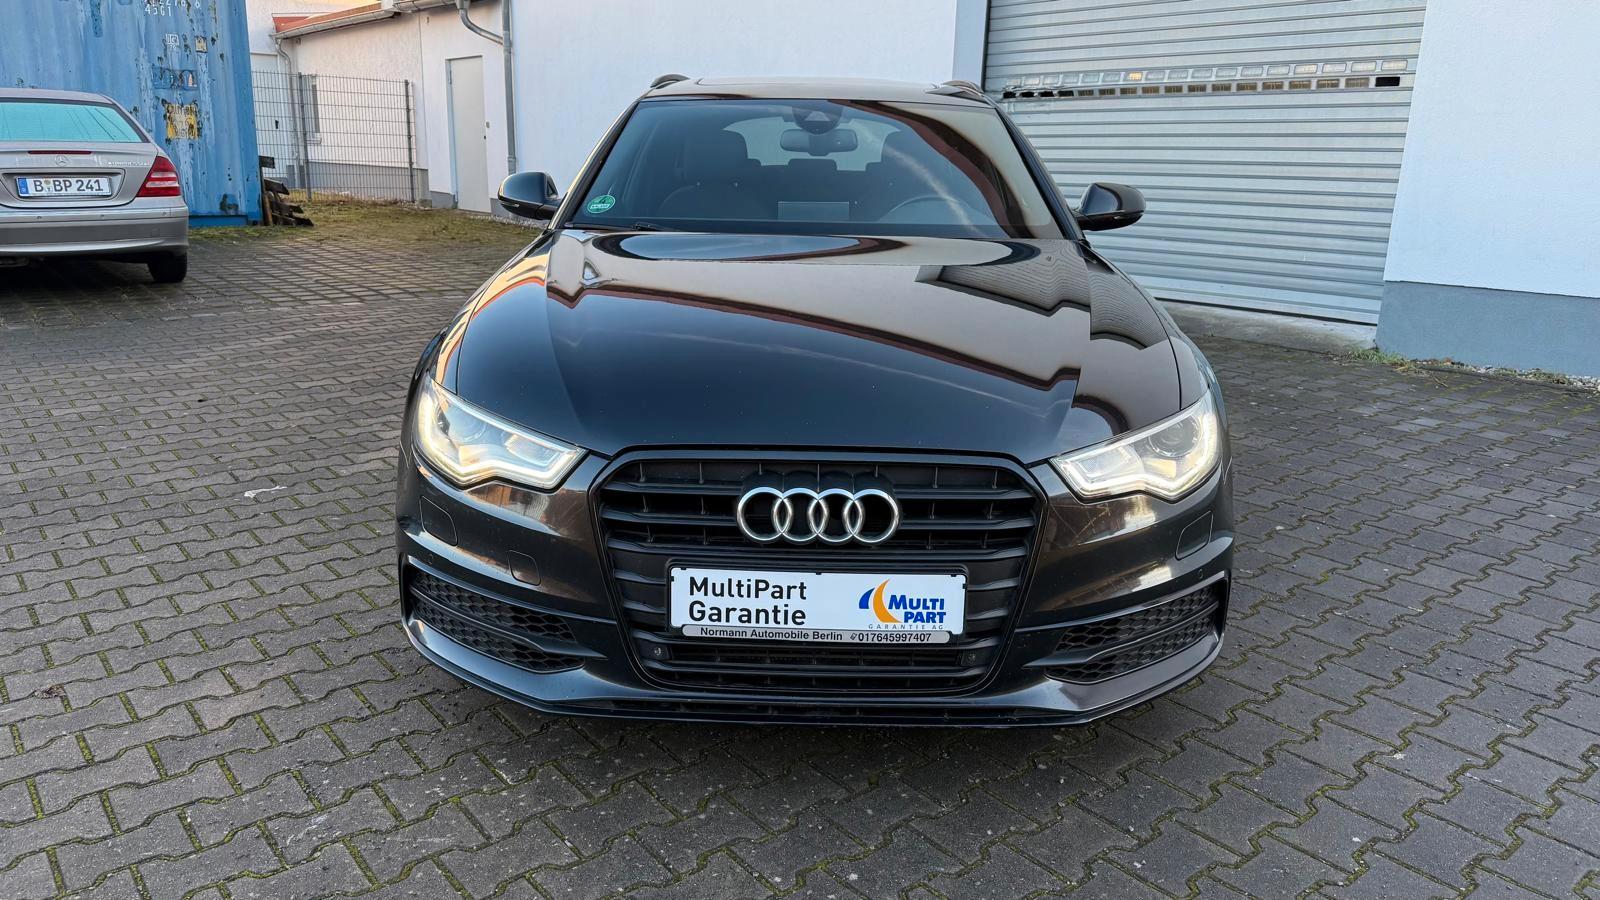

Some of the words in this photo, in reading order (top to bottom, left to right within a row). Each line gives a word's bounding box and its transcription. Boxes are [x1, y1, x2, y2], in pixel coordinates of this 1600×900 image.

[33, 179, 44, 192] B
[53, 179, 73, 192] BP
[76, 179, 104, 192] 241
[689, 576, 807, 600] MultiPart
[888, 594, 945, 610] MULTI
[689, 600, 807, 626] Garantie
[903, 611, 947, 624] PART
[700, 627, 748, 637] Normann
[750, 629, 810, 639] Automobile
[812, 631, 843, 641] Berlin
[857, 632, 932, 642] 017645997407
